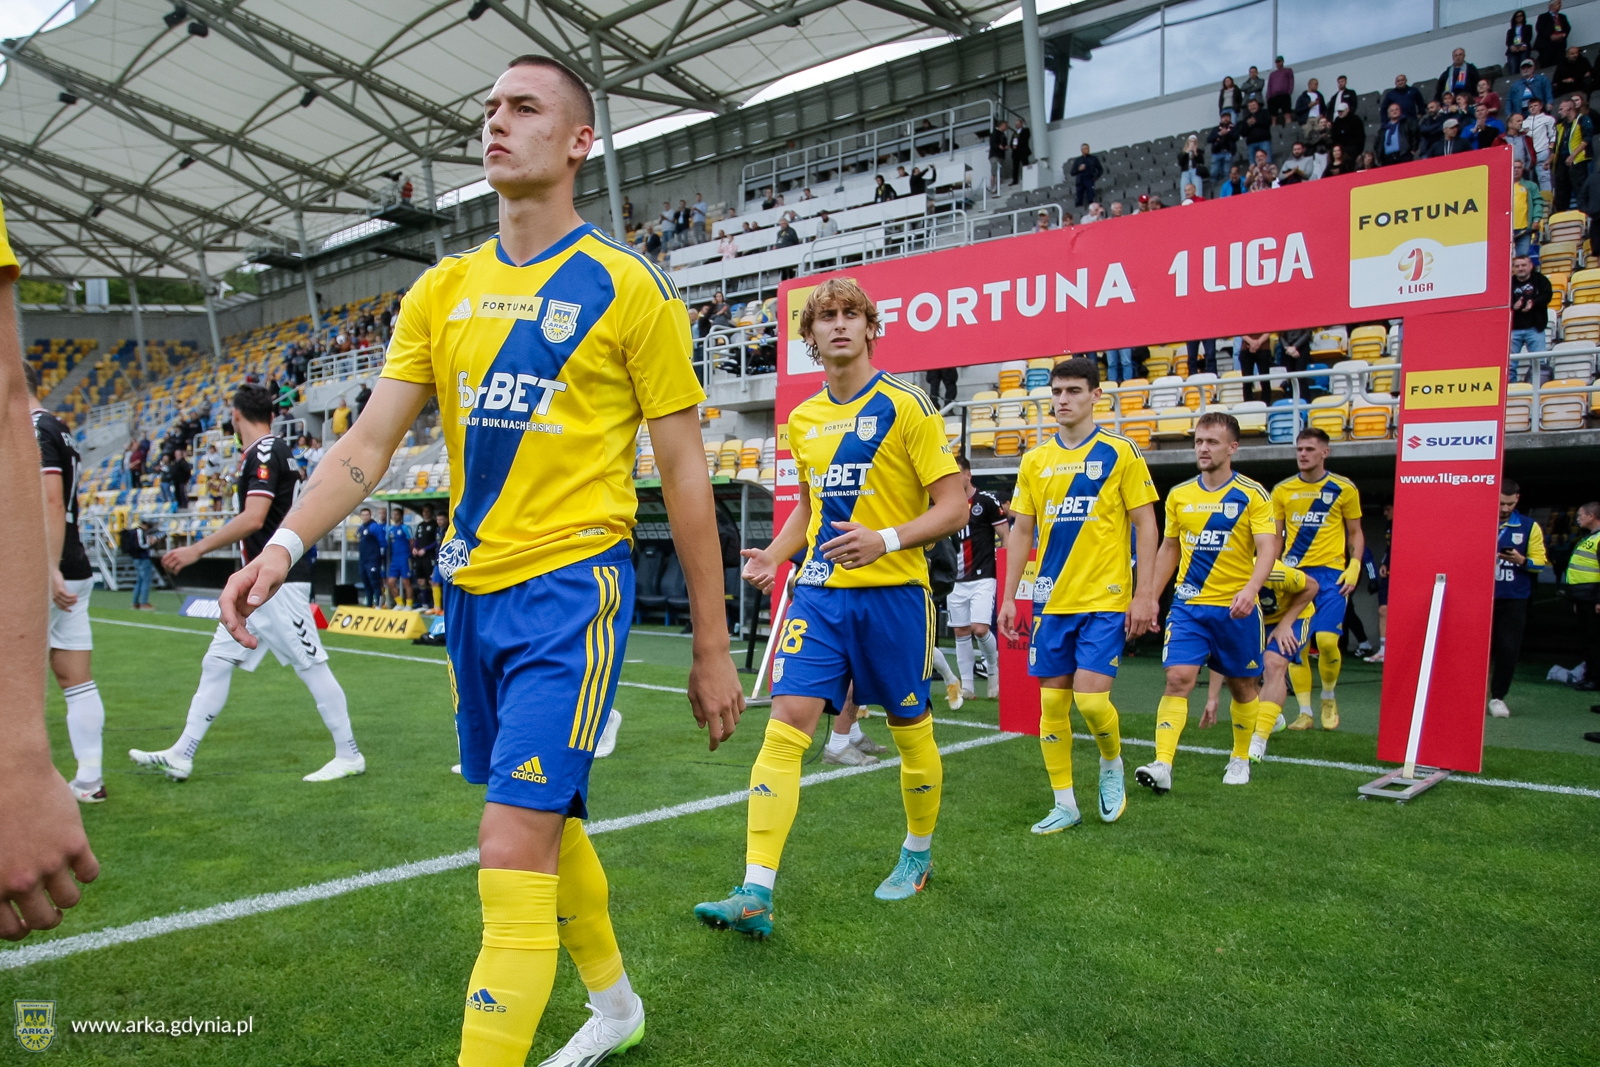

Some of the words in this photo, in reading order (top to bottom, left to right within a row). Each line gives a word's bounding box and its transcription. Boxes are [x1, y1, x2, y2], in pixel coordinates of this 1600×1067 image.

[1358, 198, 1479, 231] FORTUNA
[876, 262, 1136, 338] FORTUNA
[1167, 250, 1189, 297] 1
[1202, 232, 1314, 292] LIGA
[1397, 285, 1403, 295] 1
[1408, 282, 1434, 294] LIGA
[482, 301, 534, 312] FORTUNA
[549, 322, 569, 331] ARKA
[457, 371, 568, 416] forBET
[1411, 382, 1493, 395] FORTUNA
[482, 418, 563, 434] BUKMACHERSKIE
[824, 422, 853, 432] FORTUNA
[1426, 435, 1493, 447] SUZUKI
[1400, 473, 1495, 485] www.1liga.org
[1045, 496, 1099, 516] forBET
[1292, 511, 1330, 523] forBET
[1185, 530, 1233, 545] forBET
[1495, 569, 1515, 581] UB
[332, 612, 408, 635] FORTUNA
[1007, 641, 1029, 651] SELE
[511, 770, 547, 784] adidas
